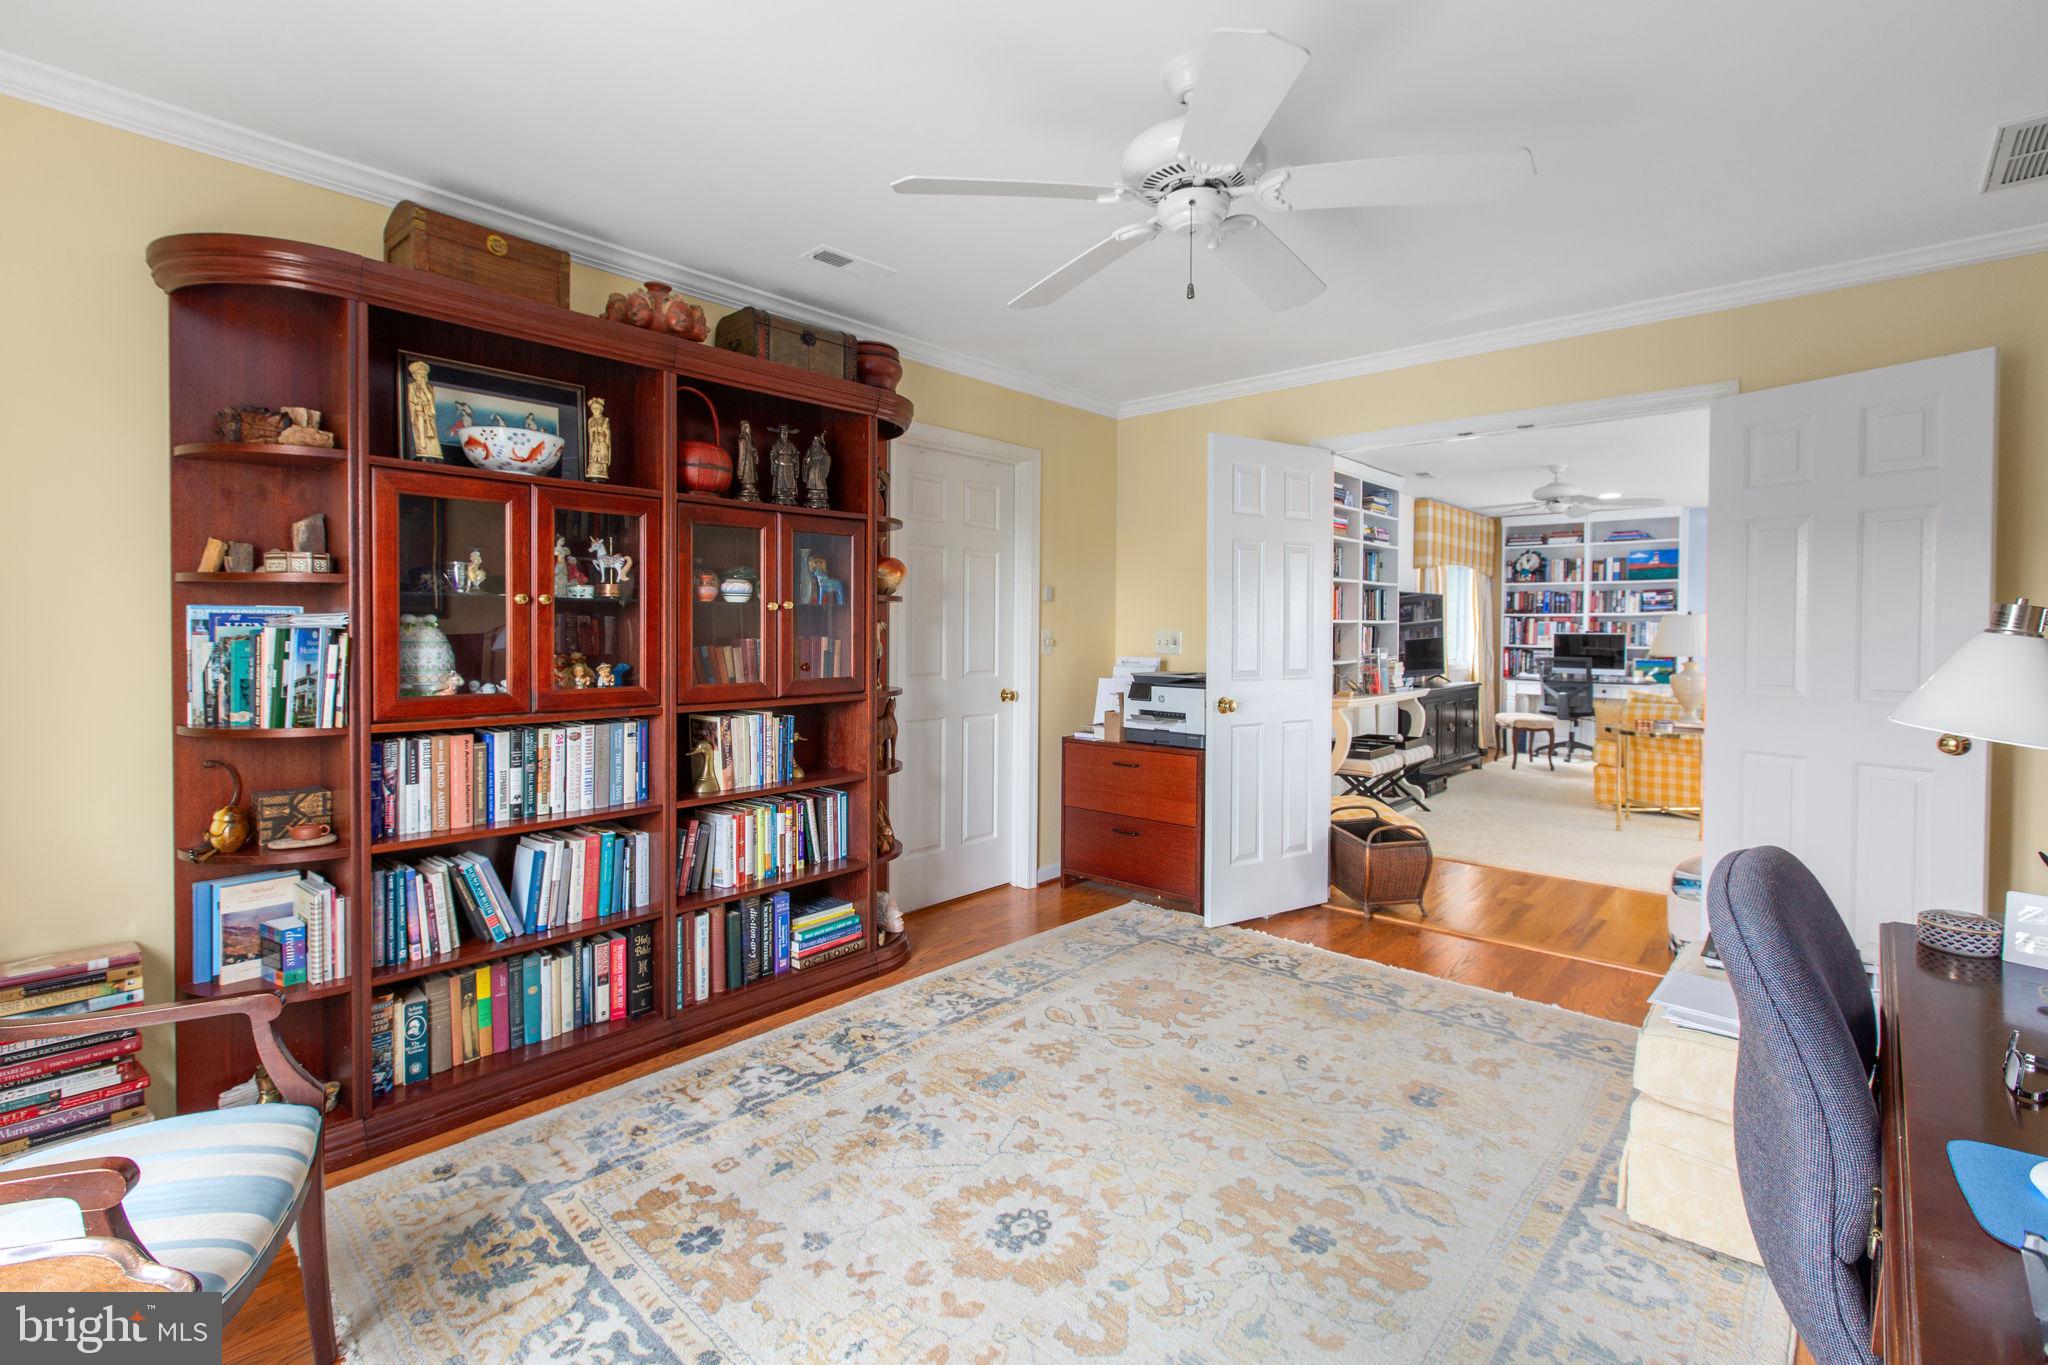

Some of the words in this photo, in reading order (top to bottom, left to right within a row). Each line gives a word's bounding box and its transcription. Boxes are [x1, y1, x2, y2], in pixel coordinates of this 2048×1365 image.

[464, 740, 470, 749] An
[555, 734, 564, 745] 24
[437, 765, 445, 788] BLIND
[437, 790, 446, 827] AMBITION
[634, 934, 651, 946] Holy
[285, 931, 303, 967] dreams
[634, 945, 651, 957] Bible
[80, 1034, 118, 1048] AMERICA
[93, 1047, 118, 1058] MATTER
